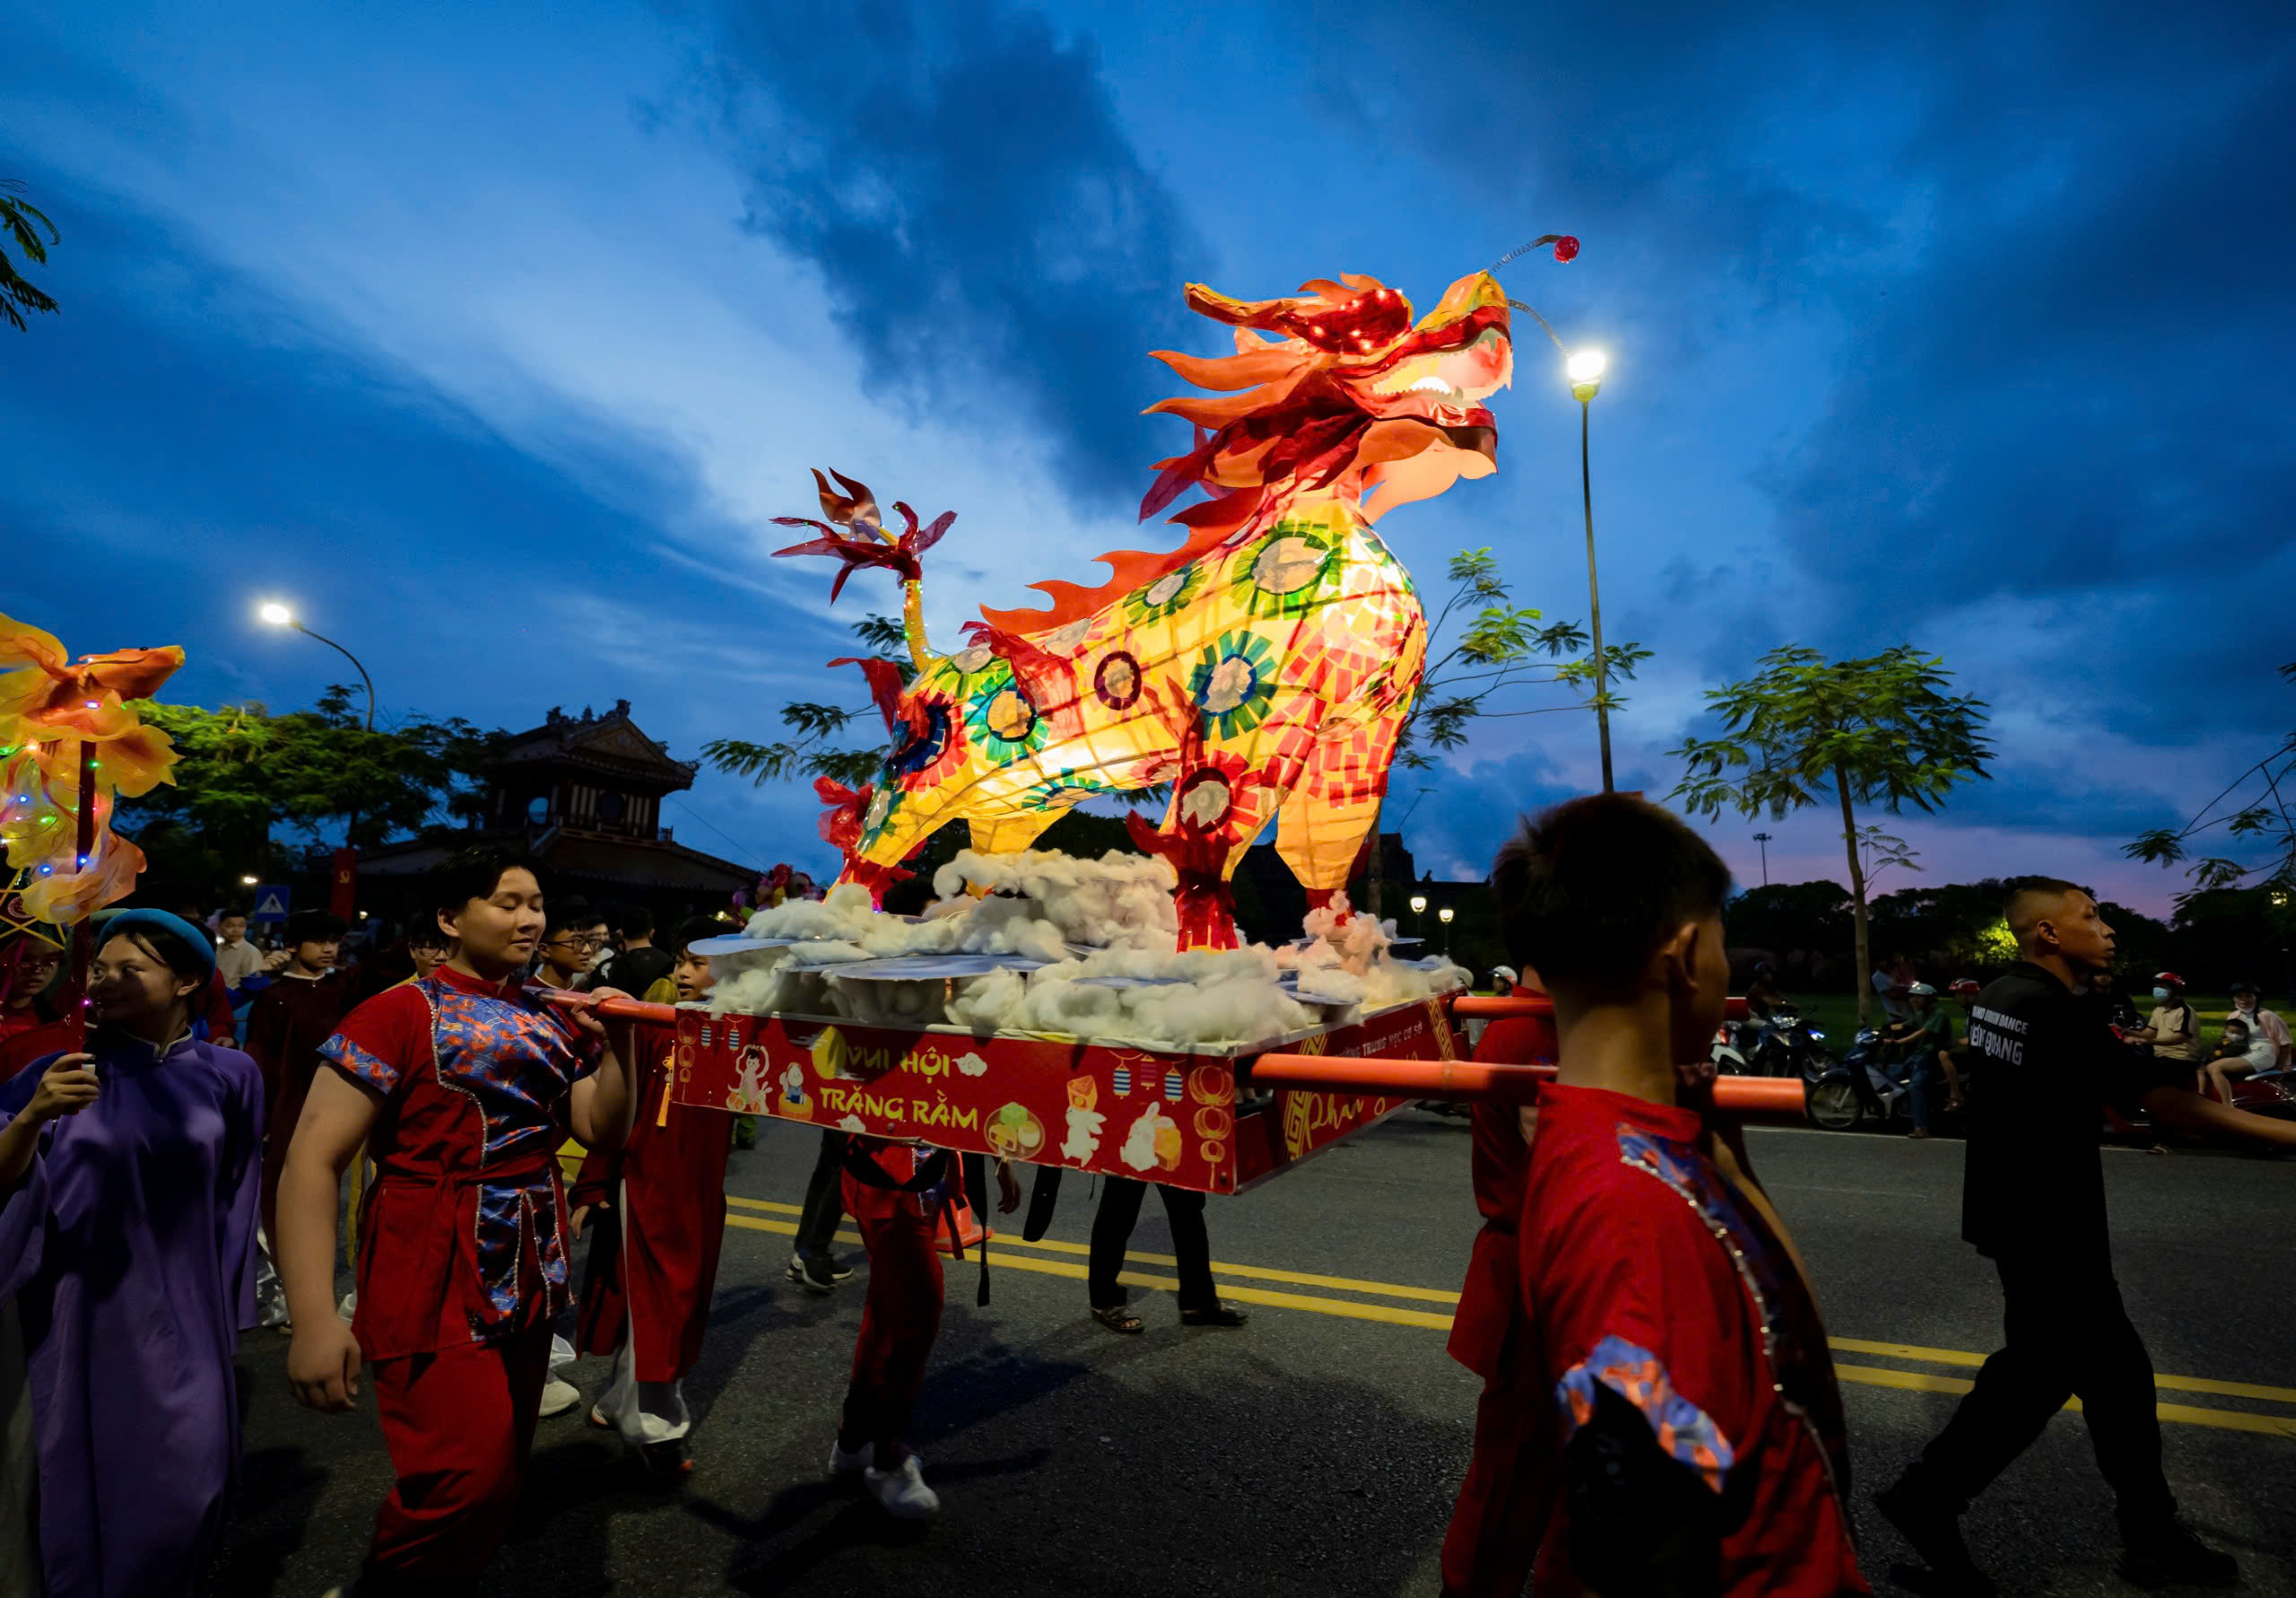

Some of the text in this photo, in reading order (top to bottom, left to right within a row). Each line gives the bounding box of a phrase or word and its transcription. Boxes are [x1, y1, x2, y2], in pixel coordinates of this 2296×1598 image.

[1998, 1014, 2029, 1035] DANCE
[1362, 1037, 1387, 1056] TRUNG
[846, 1046, 951, 1084] VUI HỘI
[819, 1084, 979, 1133] TRĂNG RẰM
